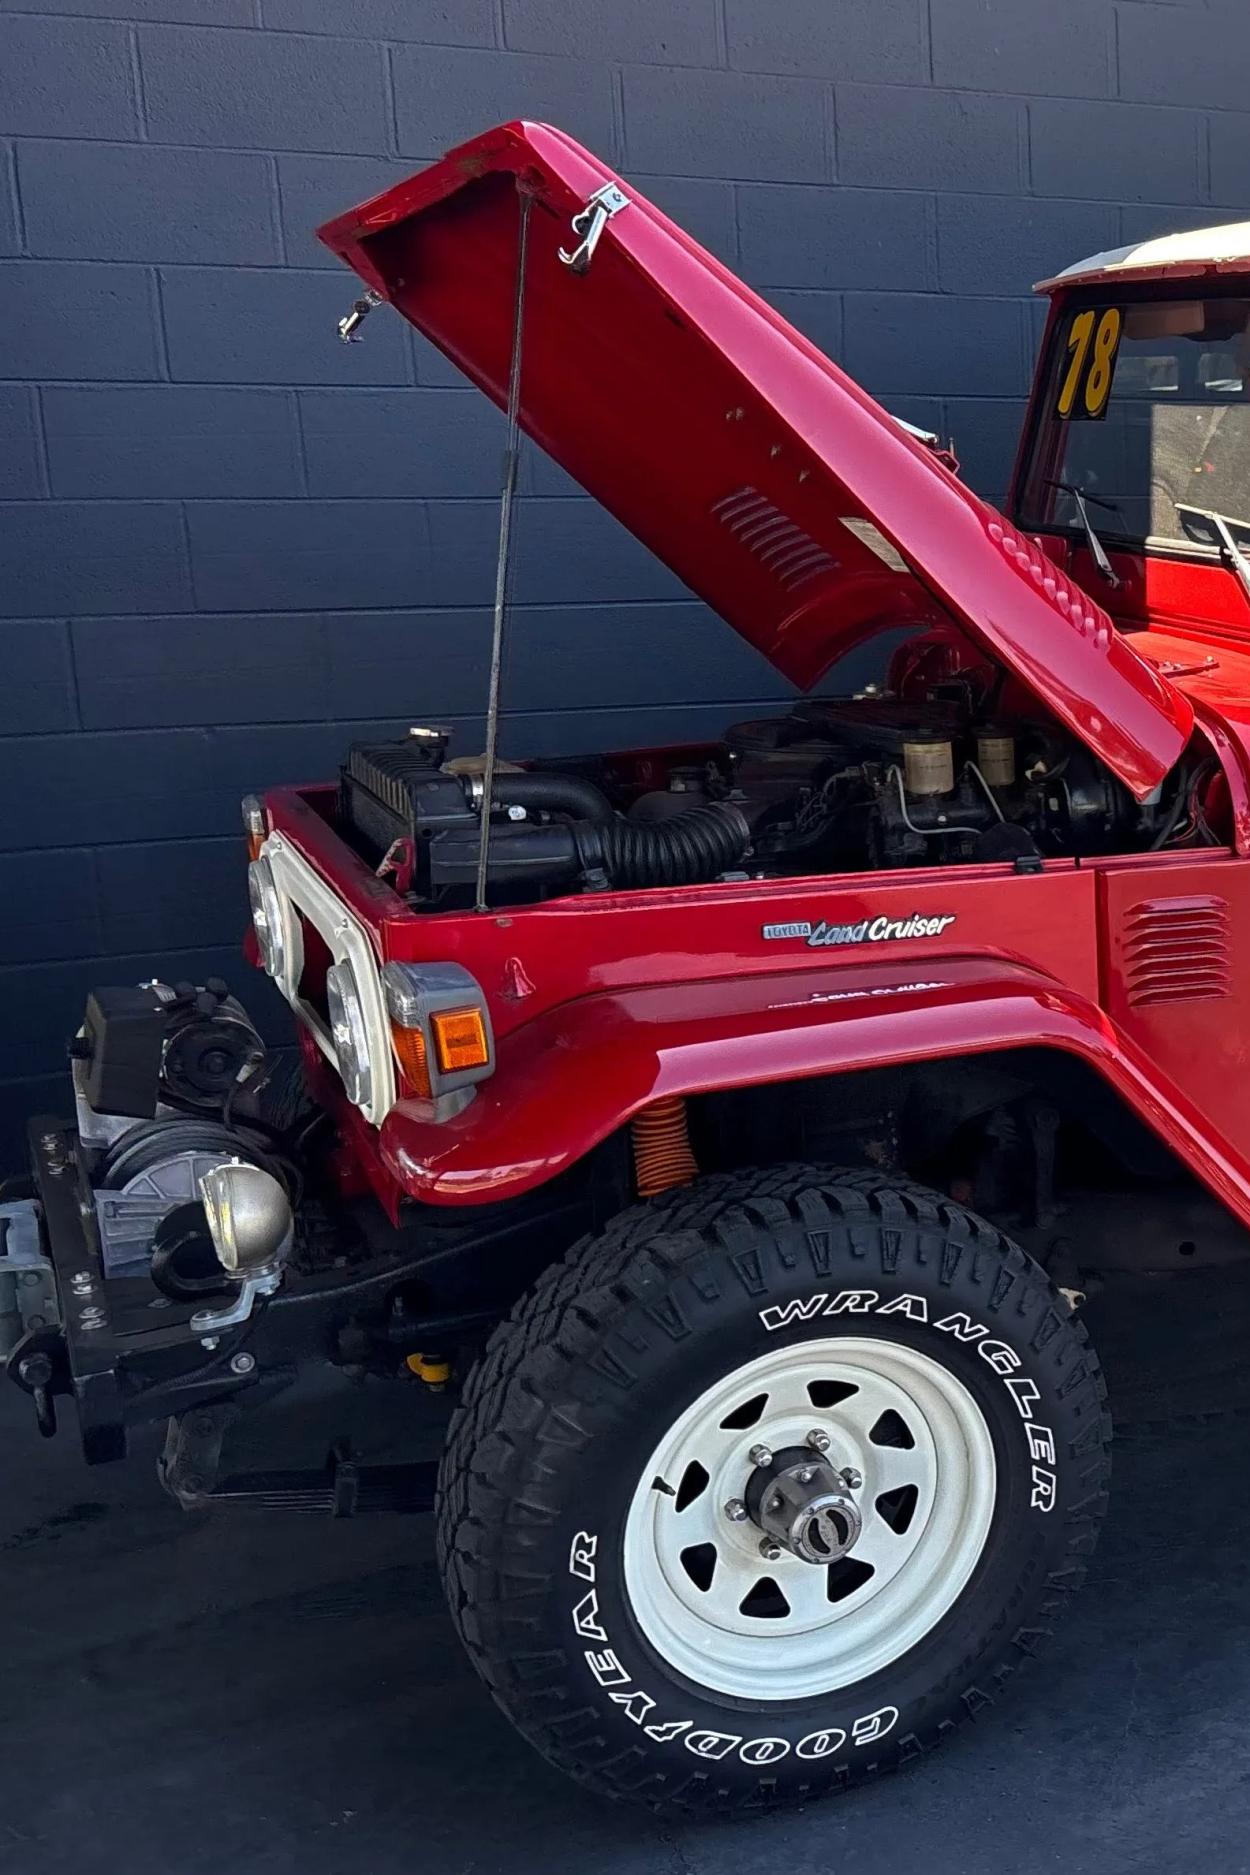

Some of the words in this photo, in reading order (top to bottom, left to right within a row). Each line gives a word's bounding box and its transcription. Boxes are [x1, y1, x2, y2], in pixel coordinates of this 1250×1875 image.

[1058, 308, 1120, 419] 78
[808, 921, 869, 946] Land
[868, 914, 956, 941] Cruiser
[759, 1289, 1056, 1512] WRANGLER
[570, 1531, 899, 1764] GOODYEAR
